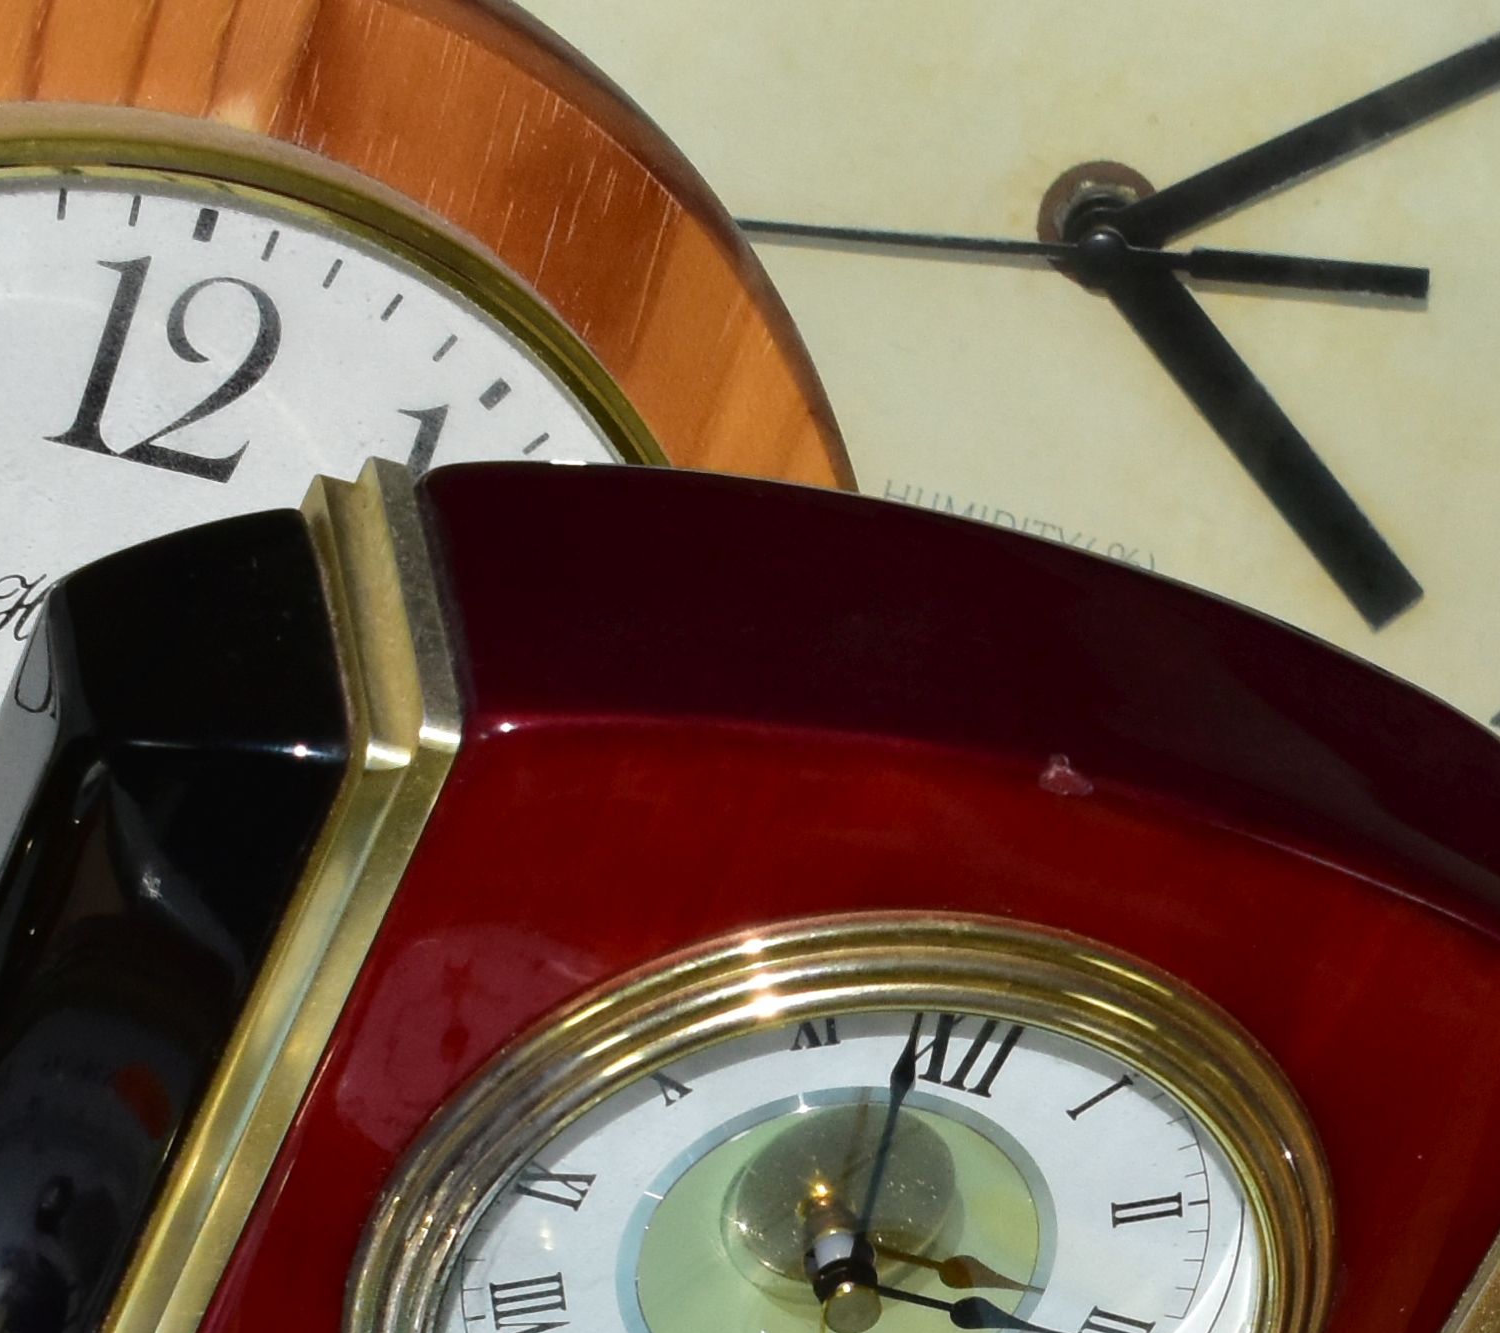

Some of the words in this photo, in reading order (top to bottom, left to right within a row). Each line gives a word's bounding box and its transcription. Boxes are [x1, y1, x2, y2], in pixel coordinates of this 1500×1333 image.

[42, 255, 282, 483] 12
[516, 1160, 597, 1212] IX
[1111, 1192, 1183, 1228] II
